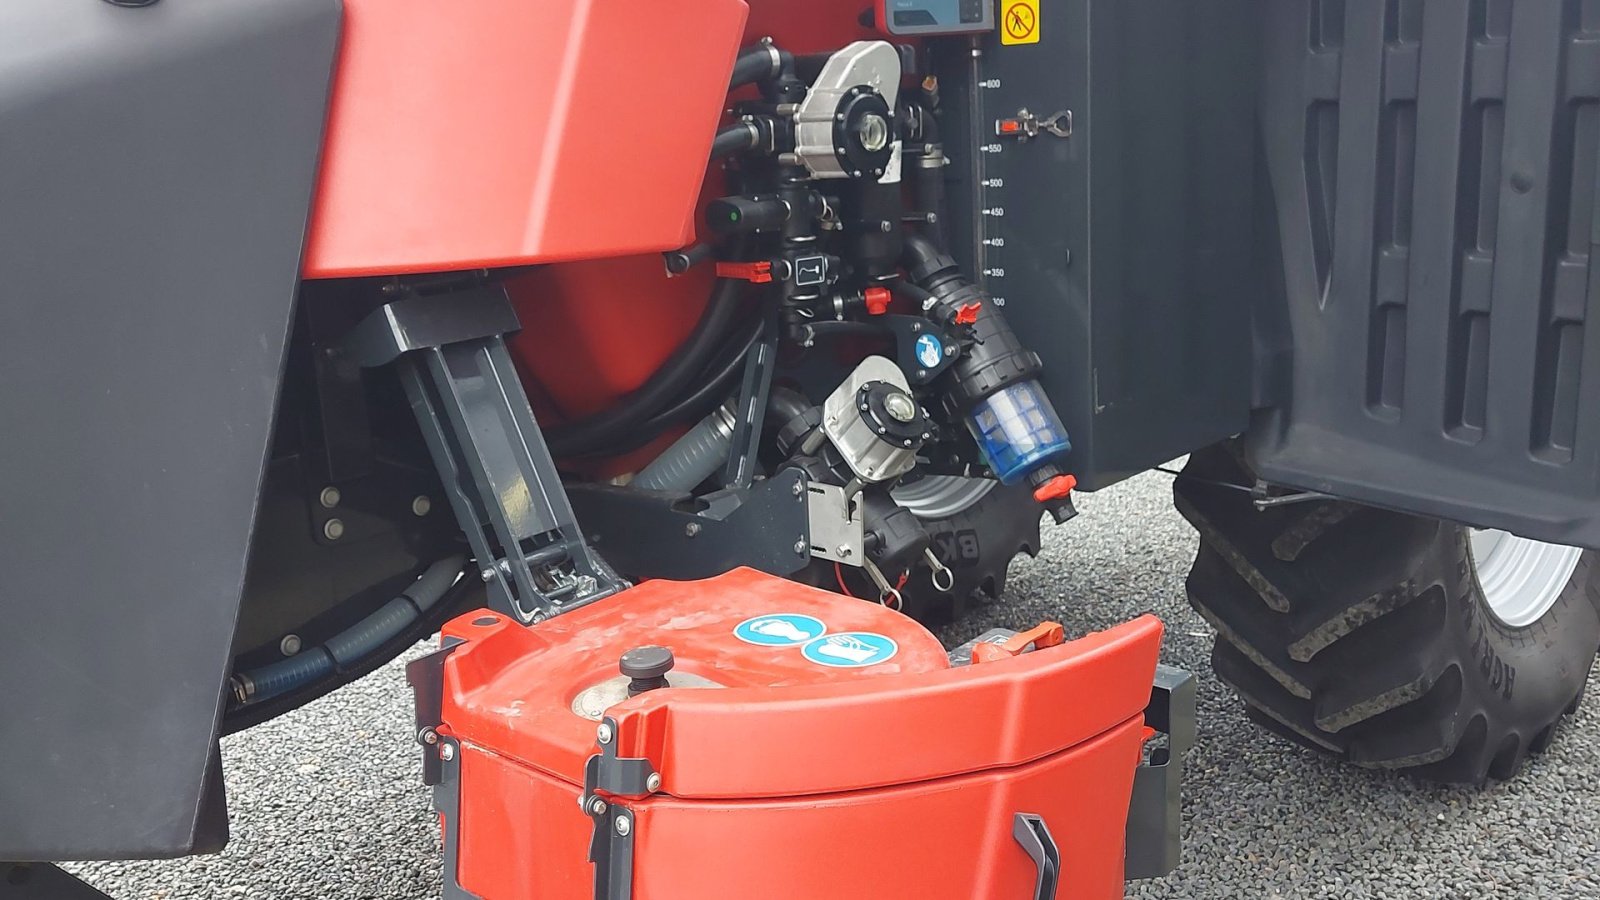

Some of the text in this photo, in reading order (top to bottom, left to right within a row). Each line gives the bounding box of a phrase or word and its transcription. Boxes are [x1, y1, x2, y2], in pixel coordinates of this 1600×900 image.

[987, 79, 1001, 88] 600
[988, 144, 1002, 153] 550
[989, 178, 1003, 187] 500
[990, 208, 1004, 216] 450
[990, 238, 1004, 247] 400
[991, 268, 1005, 277] 350
